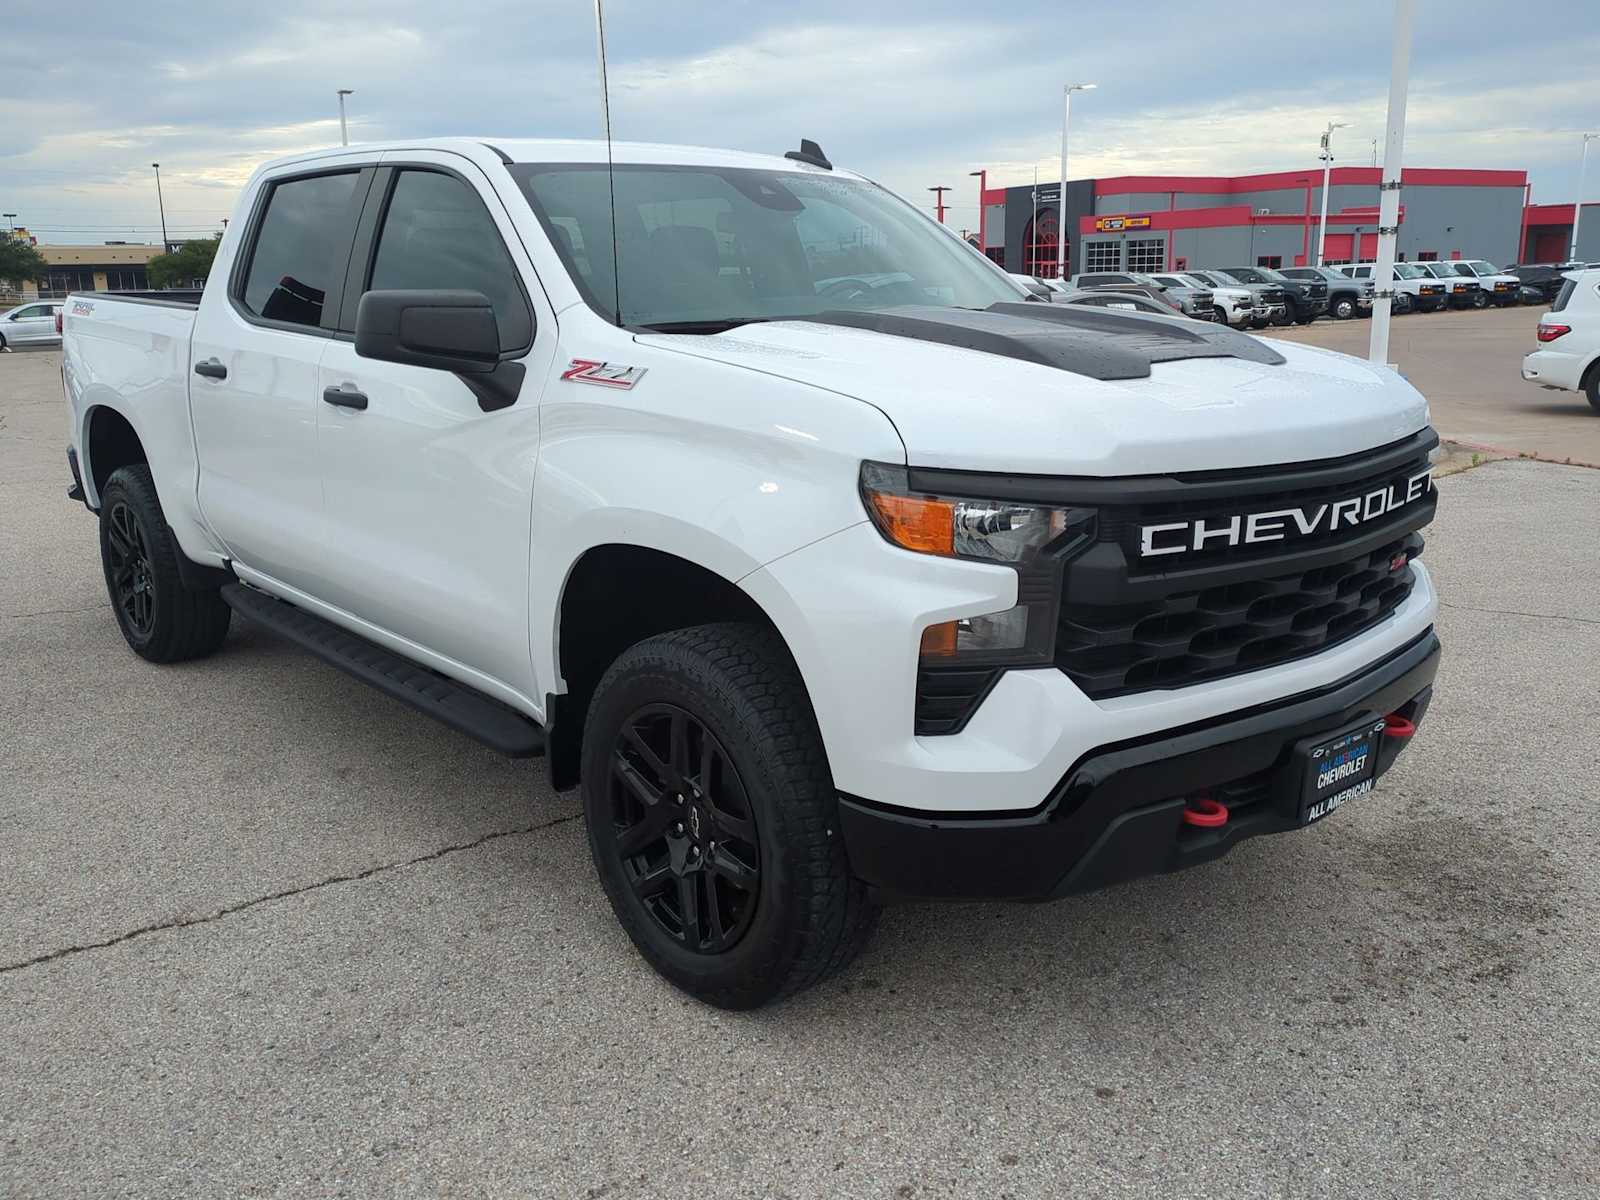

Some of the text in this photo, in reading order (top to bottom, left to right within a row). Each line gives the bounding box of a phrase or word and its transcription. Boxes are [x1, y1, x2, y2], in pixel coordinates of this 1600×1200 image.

[1141, 471, 1433, 557] CHEVROLET
[1317, 754, 1367, 789] CHEVROLET
[1334, 743, 1369, 767] AMERICAN
[1308, 779, 1373, 822] ALL AMERICAN
